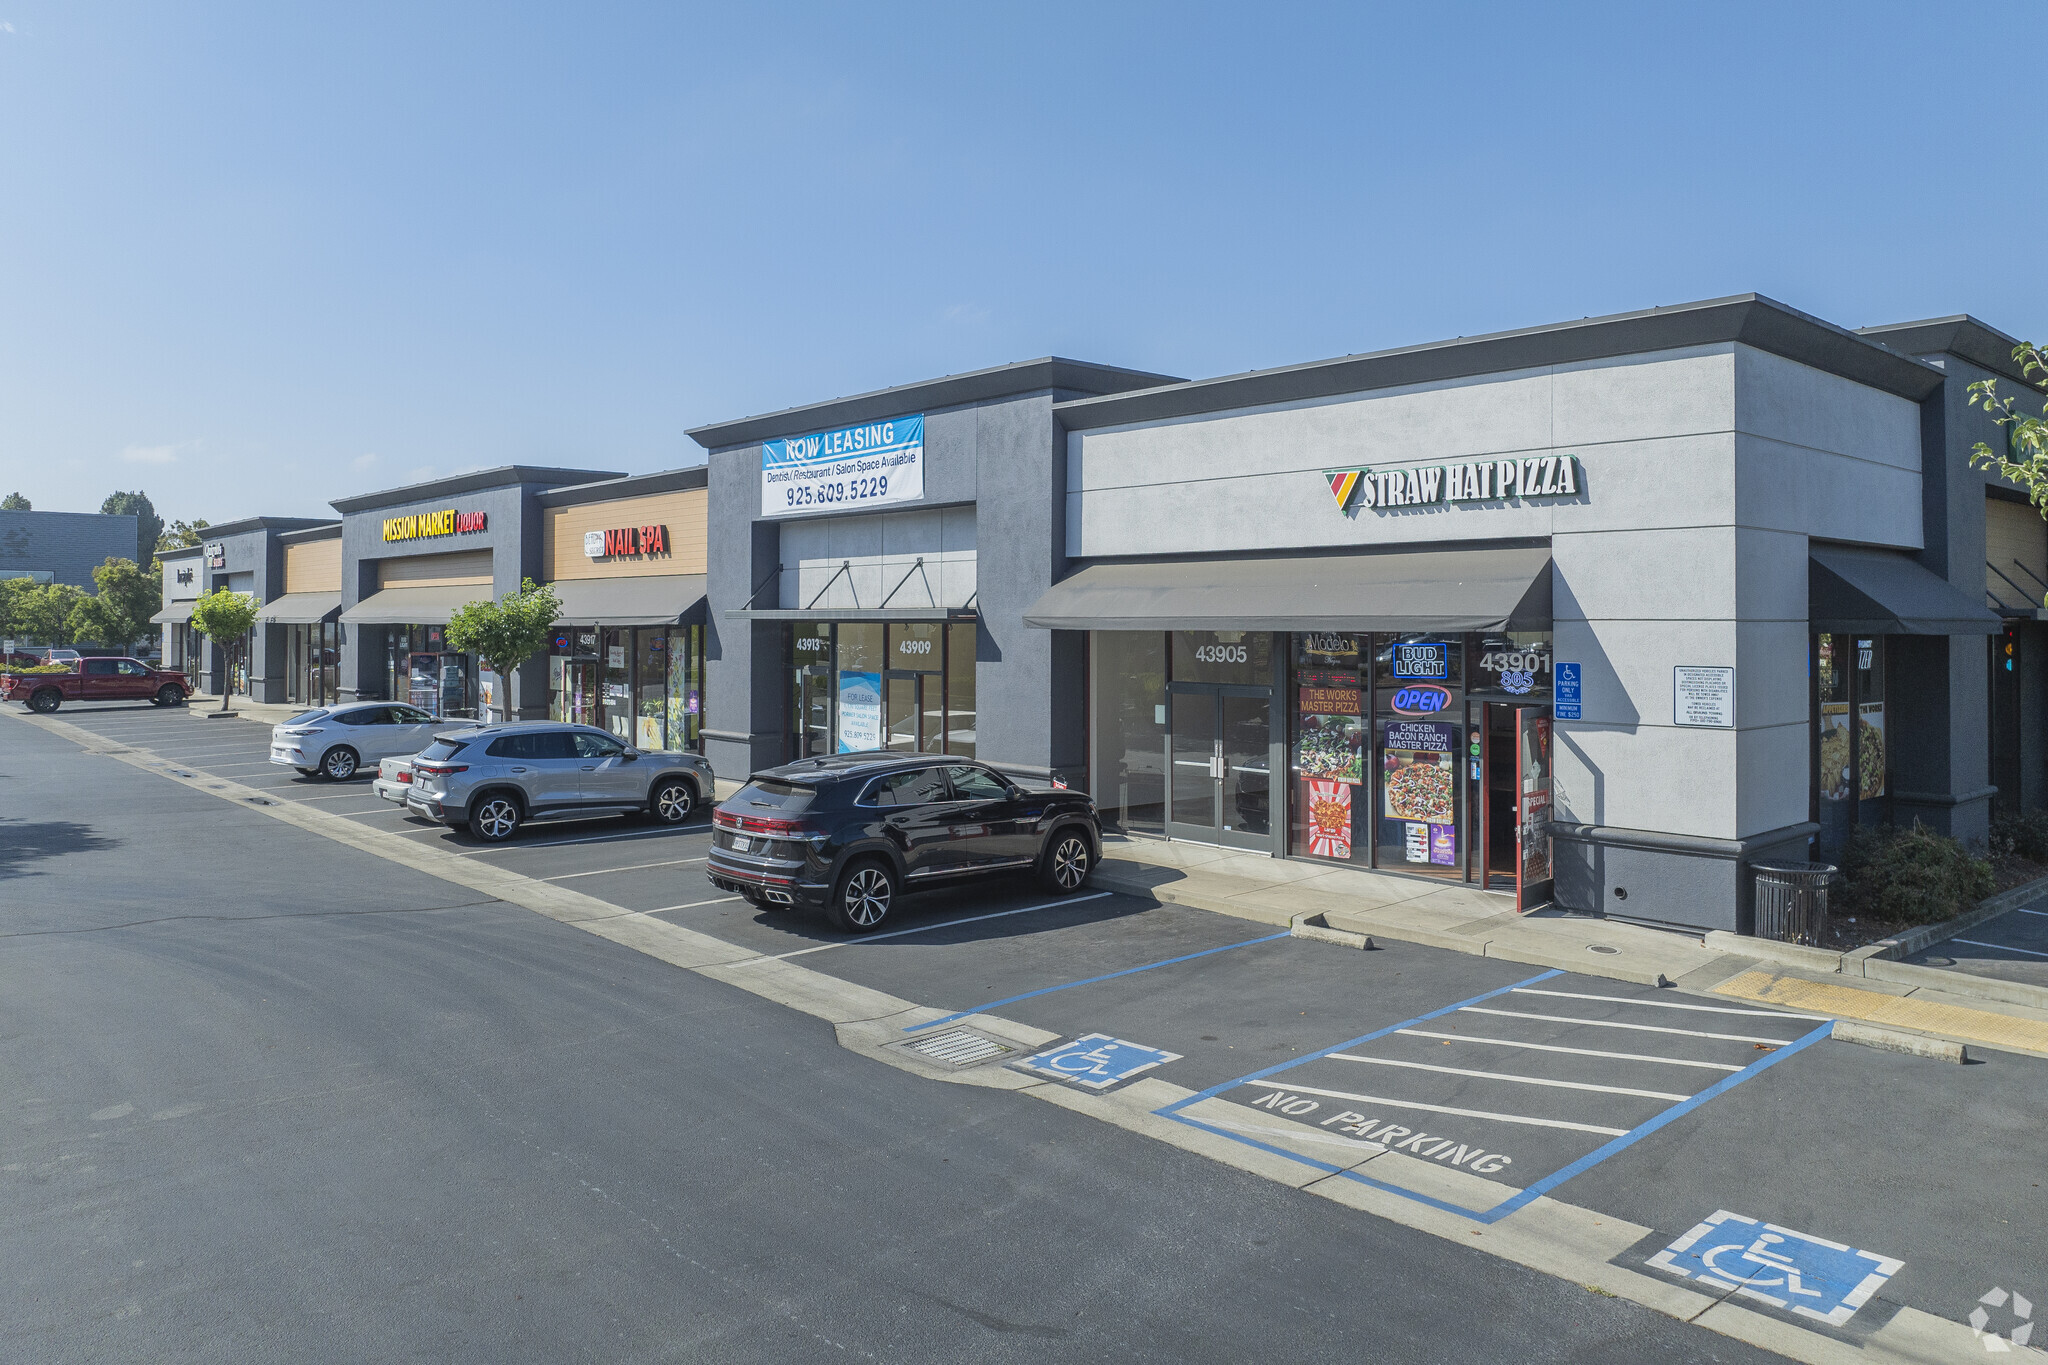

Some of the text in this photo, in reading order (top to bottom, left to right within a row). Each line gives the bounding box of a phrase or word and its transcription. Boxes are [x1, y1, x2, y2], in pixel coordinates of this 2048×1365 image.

[786, 422, 894, 460] NOW LEASING
[767, 473, 790, 483] Dentist
[794, 466, 831, 480] Restaurant
[836, 461, 856, 475] Salon
[857, 457, 880, 474] Space
[881, 452, 916, 468] Available
[1362, 454, 1576, 508] STRAW HAT PIZZA
[383, 509, 484, 541] MISSION MARKET LIQUOR
[605, 528, 636, 556] NAIL
[640, 524, 664, 554] SPA
[580, 634, 596, 645] 43917
[796, 638, 820, 651] 43913
[900, 640, 932, 654] 43909
[1309, 634, 1350, 652] Modelo
[1196, 646, 1247, 662] 43905
[1402, 647, 1437, 660] BUD
[1396, 660, 1444, 676] LIGHT
[1480, 652, 1550, 673] 43901
[1501, 671, 1534, 688] 805
[858, 694, 873, 702] LEASE
[1310, 690, 1358, 700] THE WORKS
[1394, 689, 1446, 712] OPEN
[1302, 700, 1360, 713] MASTER PIZZA
[1400, 724, 1435, 732] CHICKEN
[1388, 732, 1447, 742] BACON RANCH
[1388, 740, 1448, 752] MASTER PIZZA
[1252, 1091, 1512, 1172] NO PARKING
